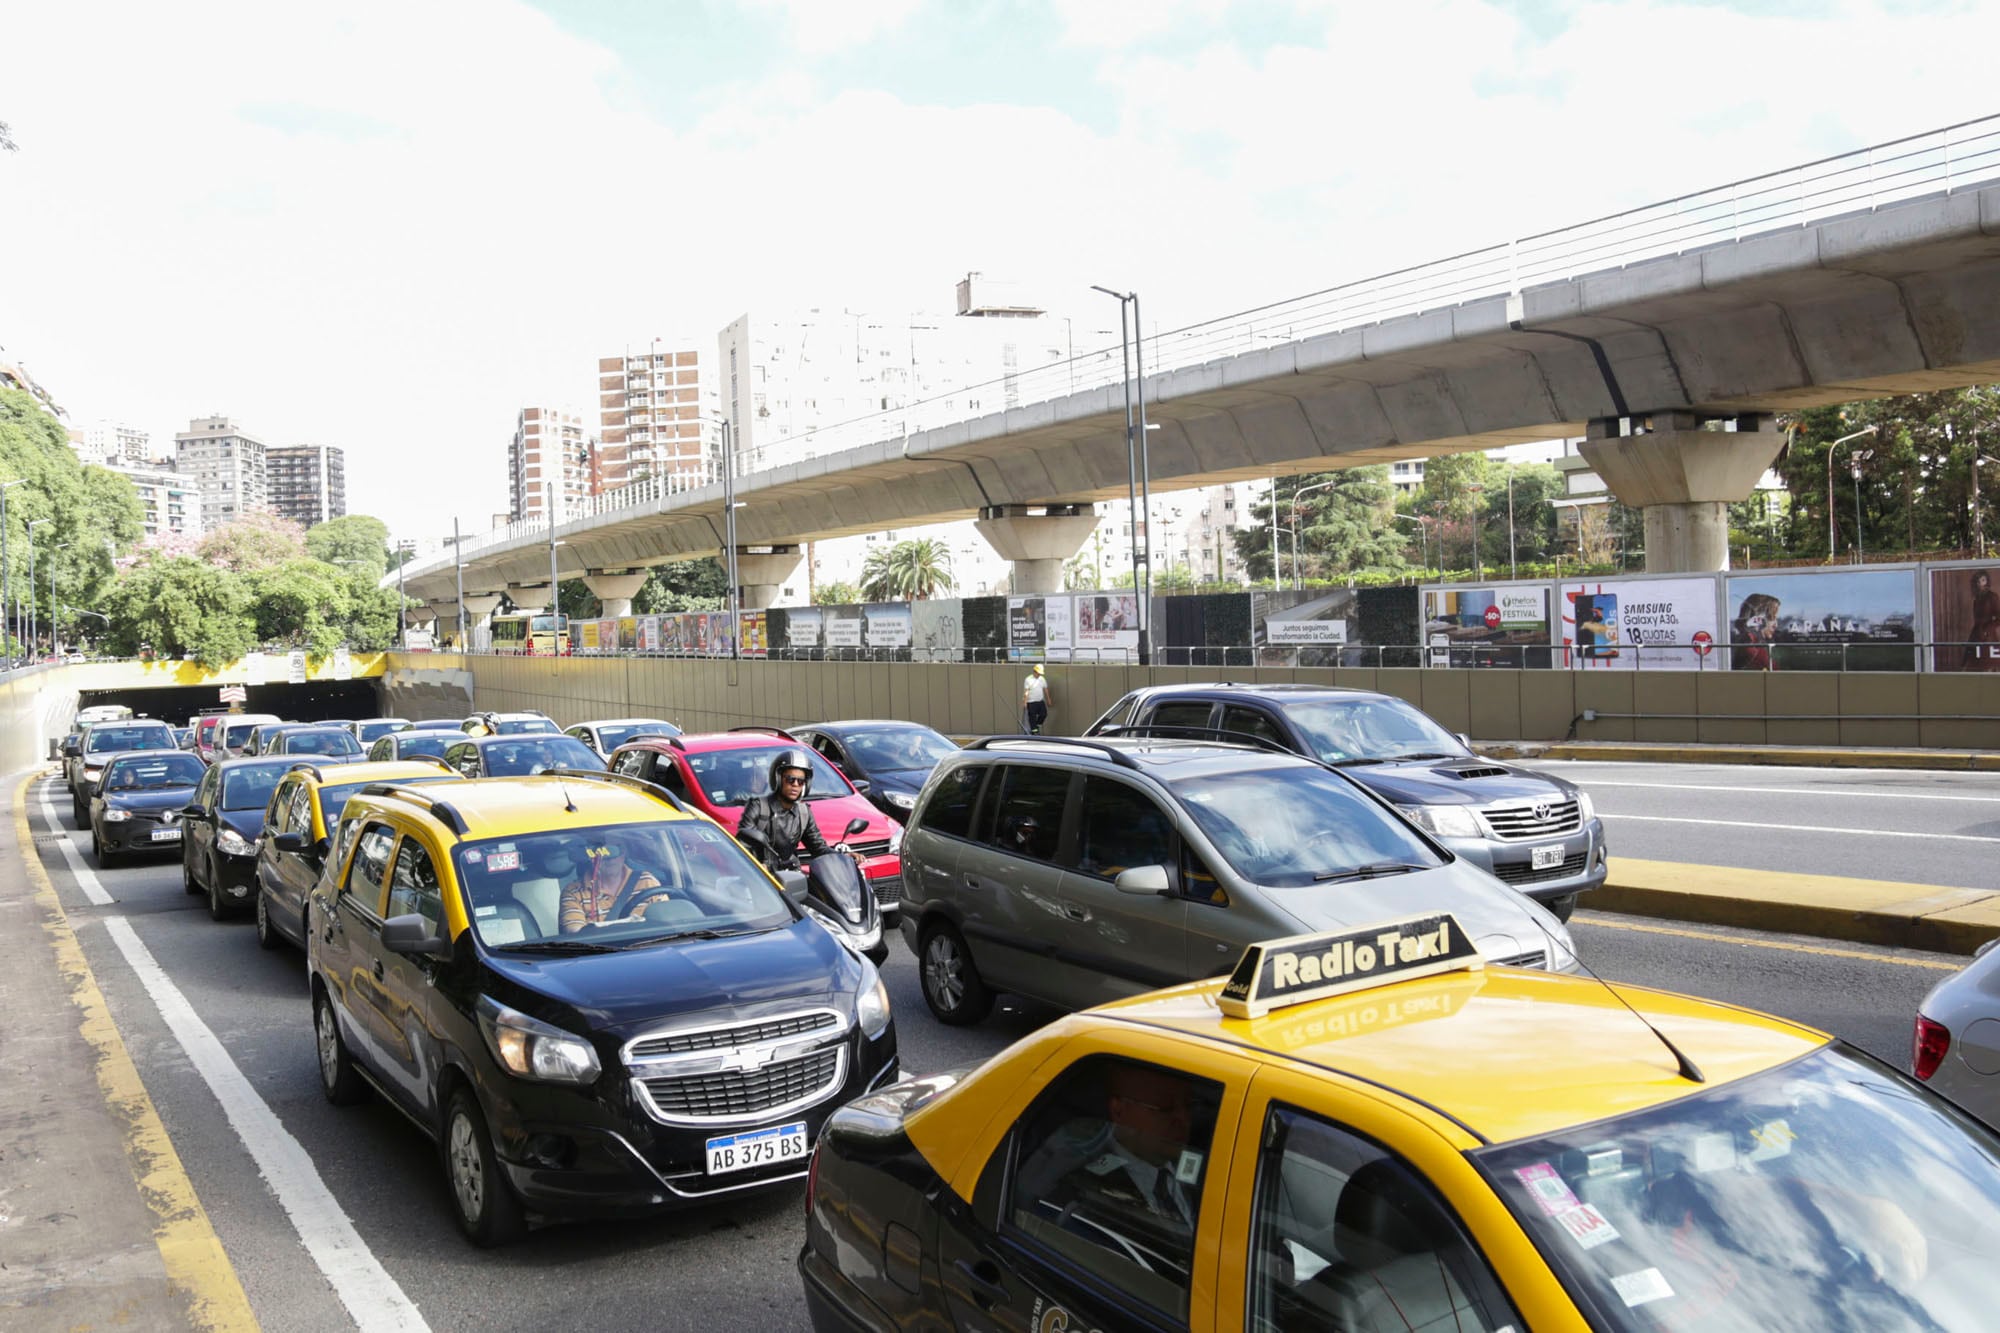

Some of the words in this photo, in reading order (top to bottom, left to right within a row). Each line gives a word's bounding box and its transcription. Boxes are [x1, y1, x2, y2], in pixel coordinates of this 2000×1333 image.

[1502, 609, 1538, 618] FESTIVAL
[1623, 602, 1672, 614] SAMSUNG
[1623, 614, 1659, 627] Galaxy
[1789, 616, 1856, 632] ARAÑA
[1302, 624, 1329, 633] seguimos
[1271, 632, 1312, 640] transformando
[1626, 627, 1643, 645] 18
[1643, 629, 1676, 641] CUOTAS
[1274, 941, 1377, 989] Radio
[1378, 922, 1450, 965] Taxi
[1226, 981, 1249, 995] Gold
[713, 1148, 735, 1171] AB
[741, 1141, 775, 1165] 375
[781, 1135, 802, 1157] BS
